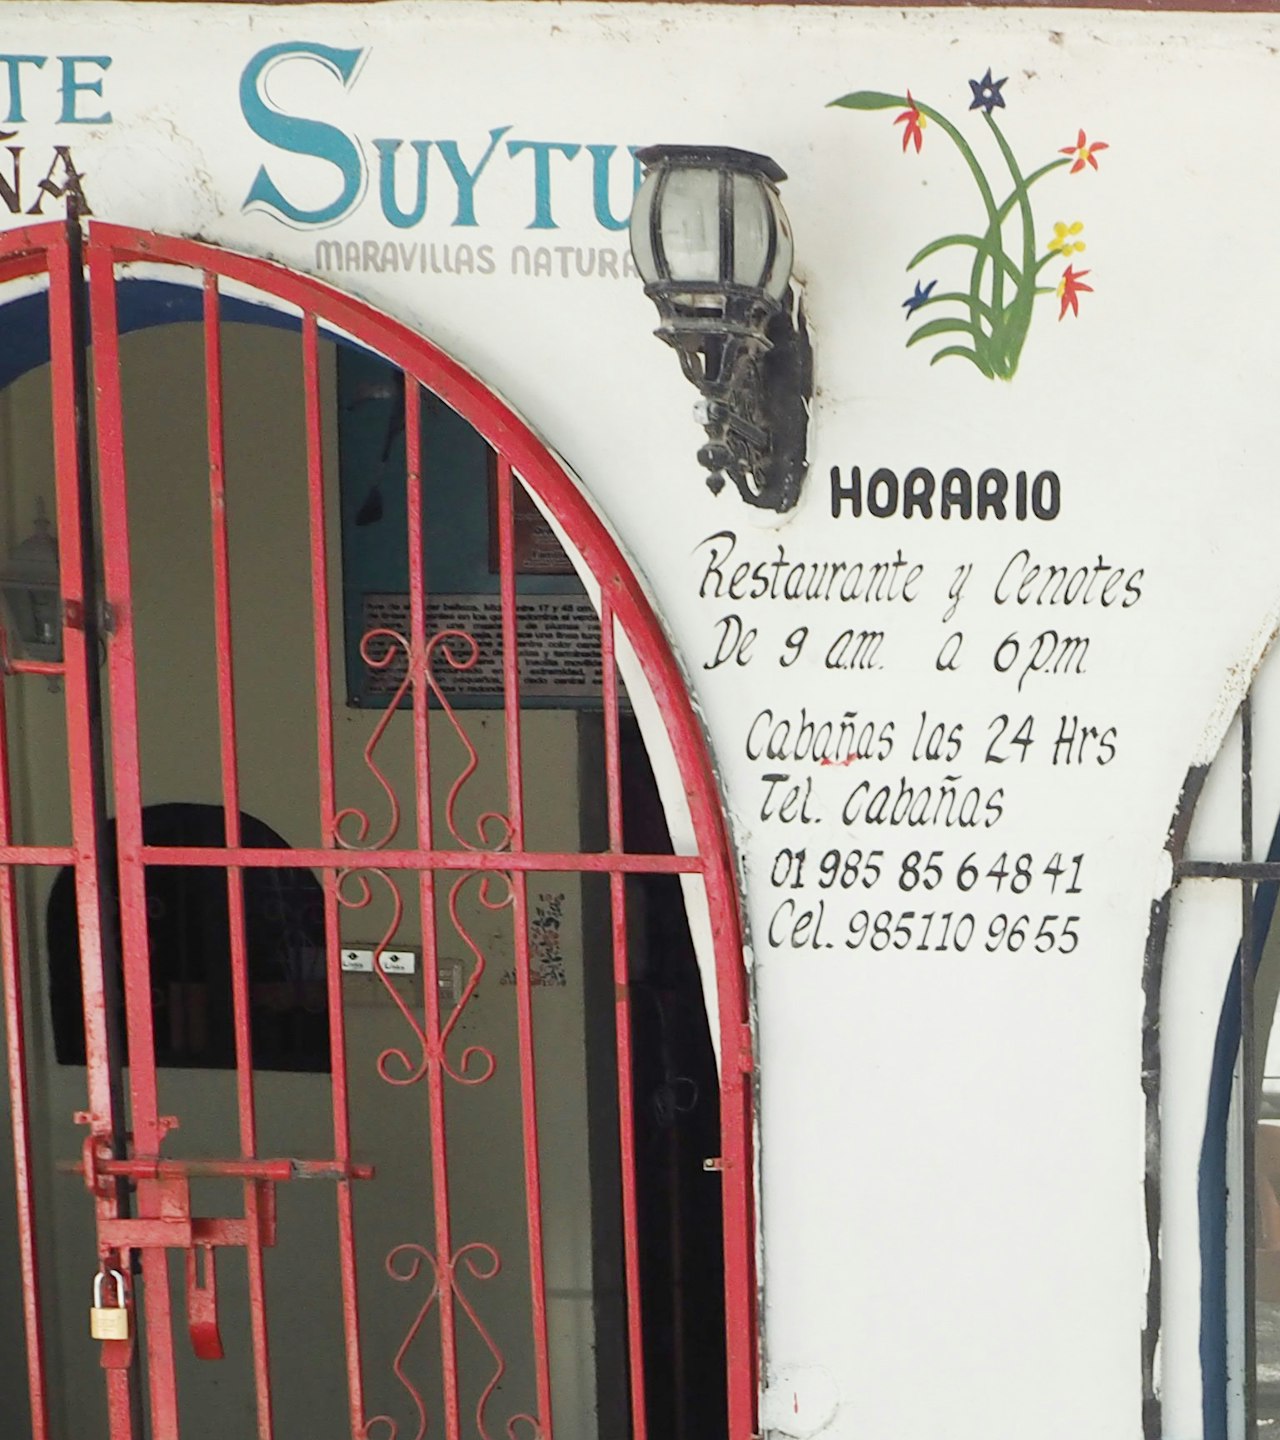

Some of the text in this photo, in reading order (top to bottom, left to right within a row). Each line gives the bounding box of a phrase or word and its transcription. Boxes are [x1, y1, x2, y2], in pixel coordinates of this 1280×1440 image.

[240, 41, 642, 232] SUYTU
[315, 239, 641, 280] MARAVILLAS NATURA
[829, 465, 1061, 522] HORARIO
[693, 531, 1145, 623] Restaurante y Cenotes
[702, 614, 758, 670] De
[779, 626, 809, 668] 9
[935, 631, 963, 672] a
[745, 707, 1117, 766] Cabañas las 24 Hrs
[760, 773, 1004, 829] Tel. cabañas
[770, 847, 806, 889] 01
[818, 849, 884, 890] 985
[768, 898, 834, 950] Cel.
